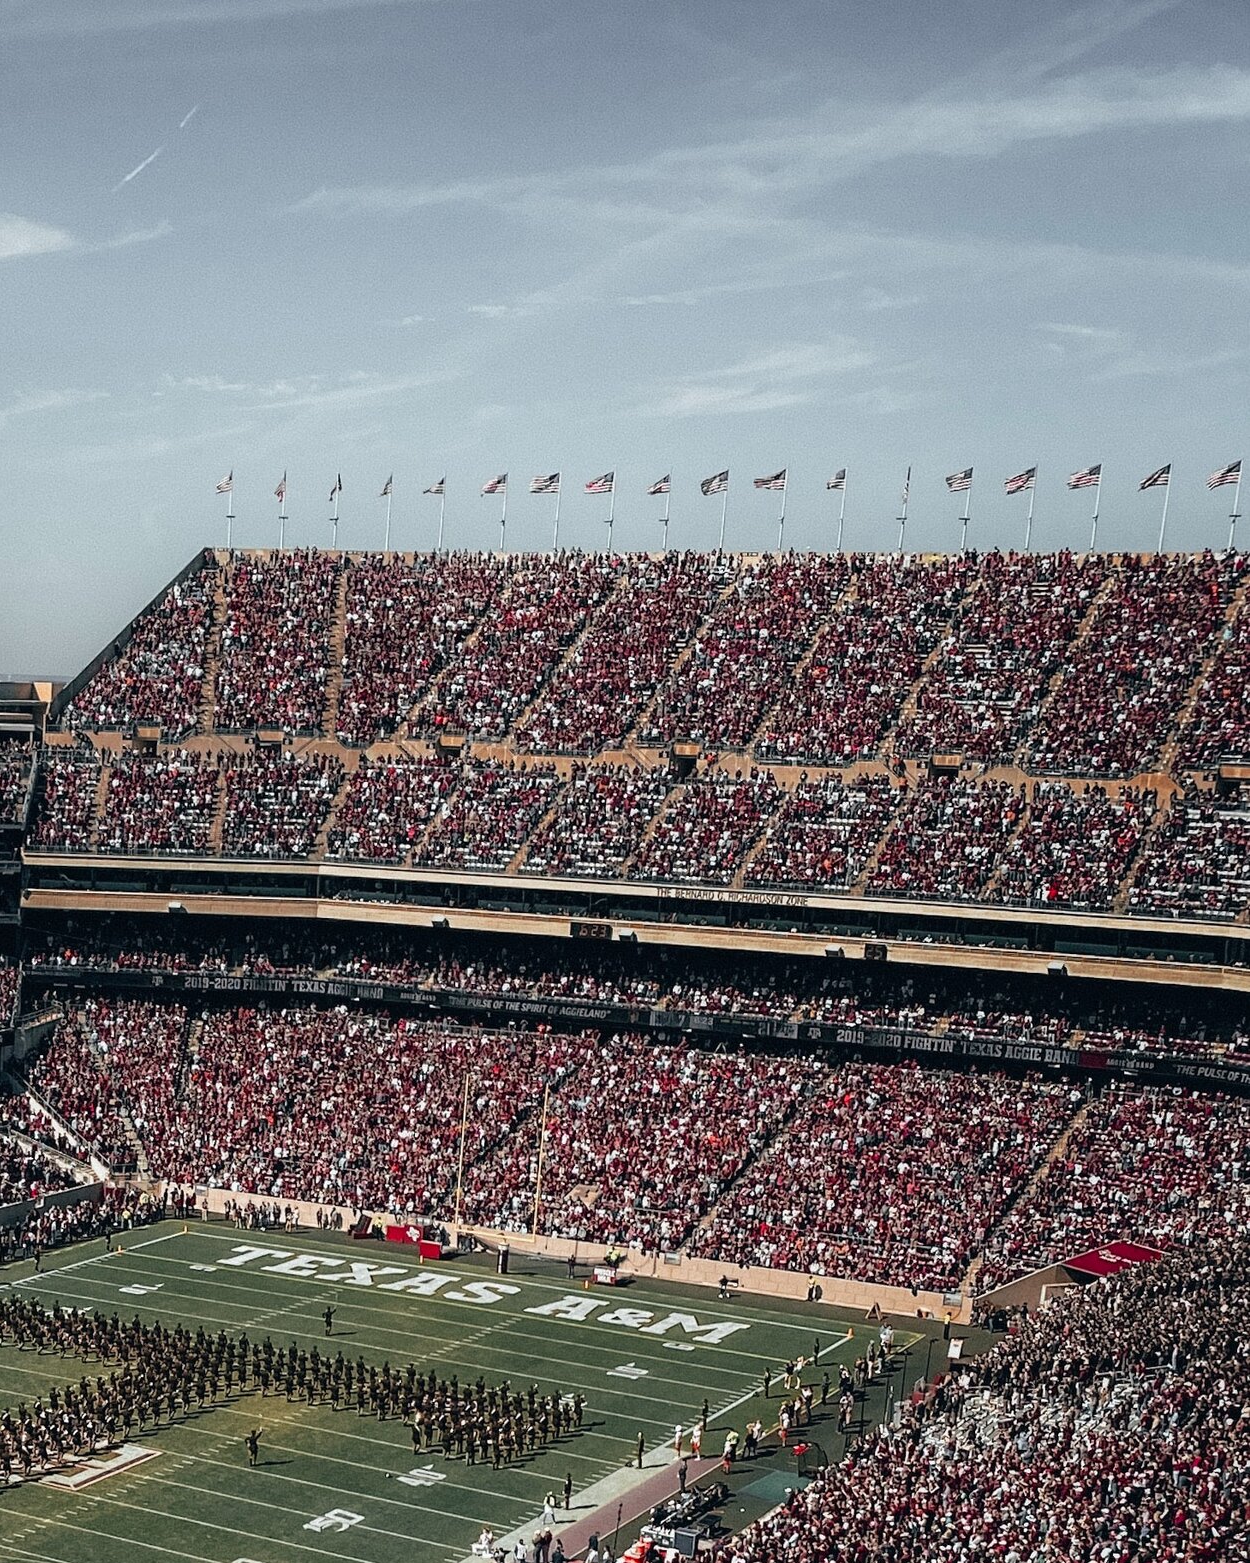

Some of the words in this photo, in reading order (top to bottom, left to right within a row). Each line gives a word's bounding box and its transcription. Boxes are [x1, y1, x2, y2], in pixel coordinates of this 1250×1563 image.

[656, 888, 672, 898] THE
[184, 976, 241, 990] 2019-2020
[292, 980, 325, 994] TEXAS
[467, 998, 492, 1008] PULSE
[493, 1000, 503, 1009] OF
[505, 1001, 520, 1011] THE
[521, 1002, 547, 1013] SPIRIT
[961, 1043, 1003, 1058] TEXAS
[1005, 1046, 1041, 1061] AGGIE
[1198, 1066, 1226, 1079] PULSE
[1227, 1069, 1240, 1081] OF
[216, 1245, 522, 1304] TEXAS
[523, 1295, 751, 1344] A&M
[302, 1508, 365, 1533] 50
